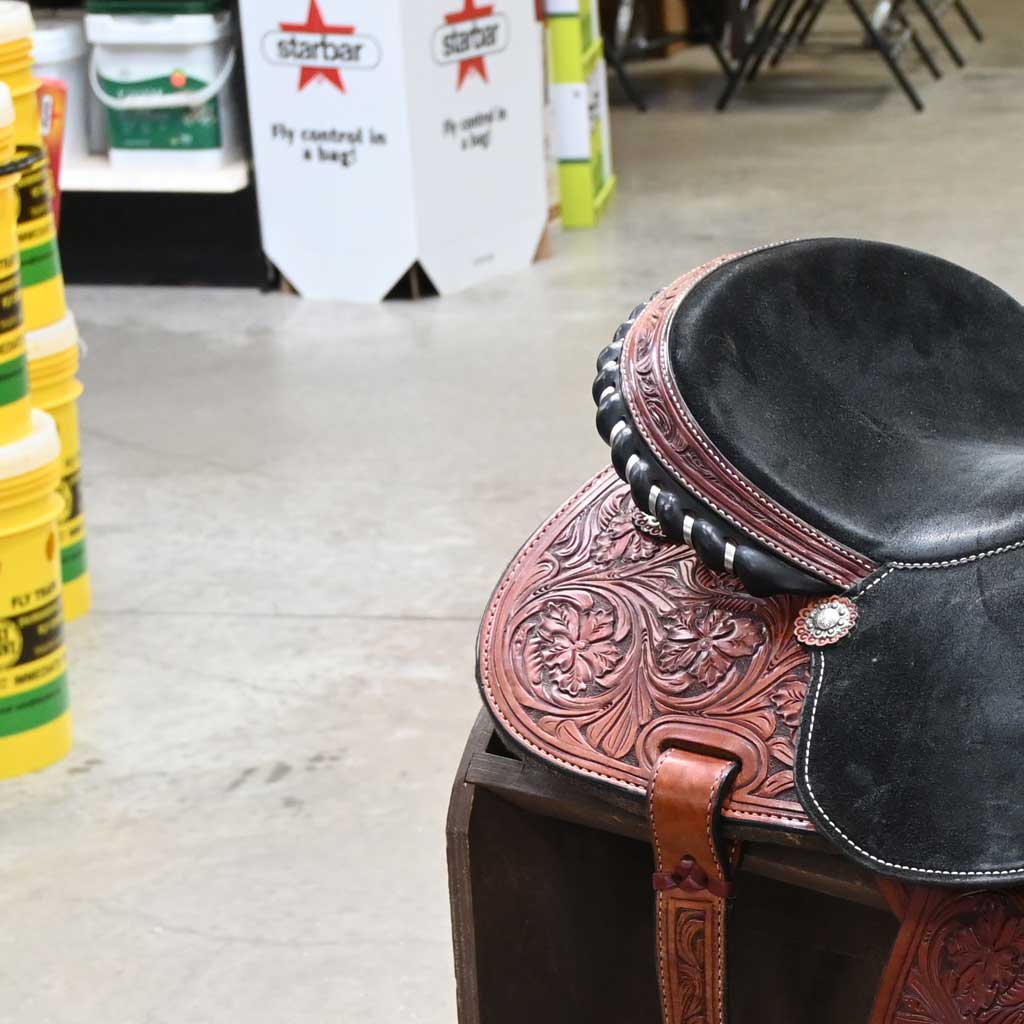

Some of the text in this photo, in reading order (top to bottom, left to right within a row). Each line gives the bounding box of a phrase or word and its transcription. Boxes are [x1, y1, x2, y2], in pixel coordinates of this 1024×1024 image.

[278, 34, 364, 61] starbar
[443, 22, 499, 57] starbar
[460, 112, 495, 130] control
[271, 123, 386, 145] Fly control in
[318, 145, 356, 168] bag!
